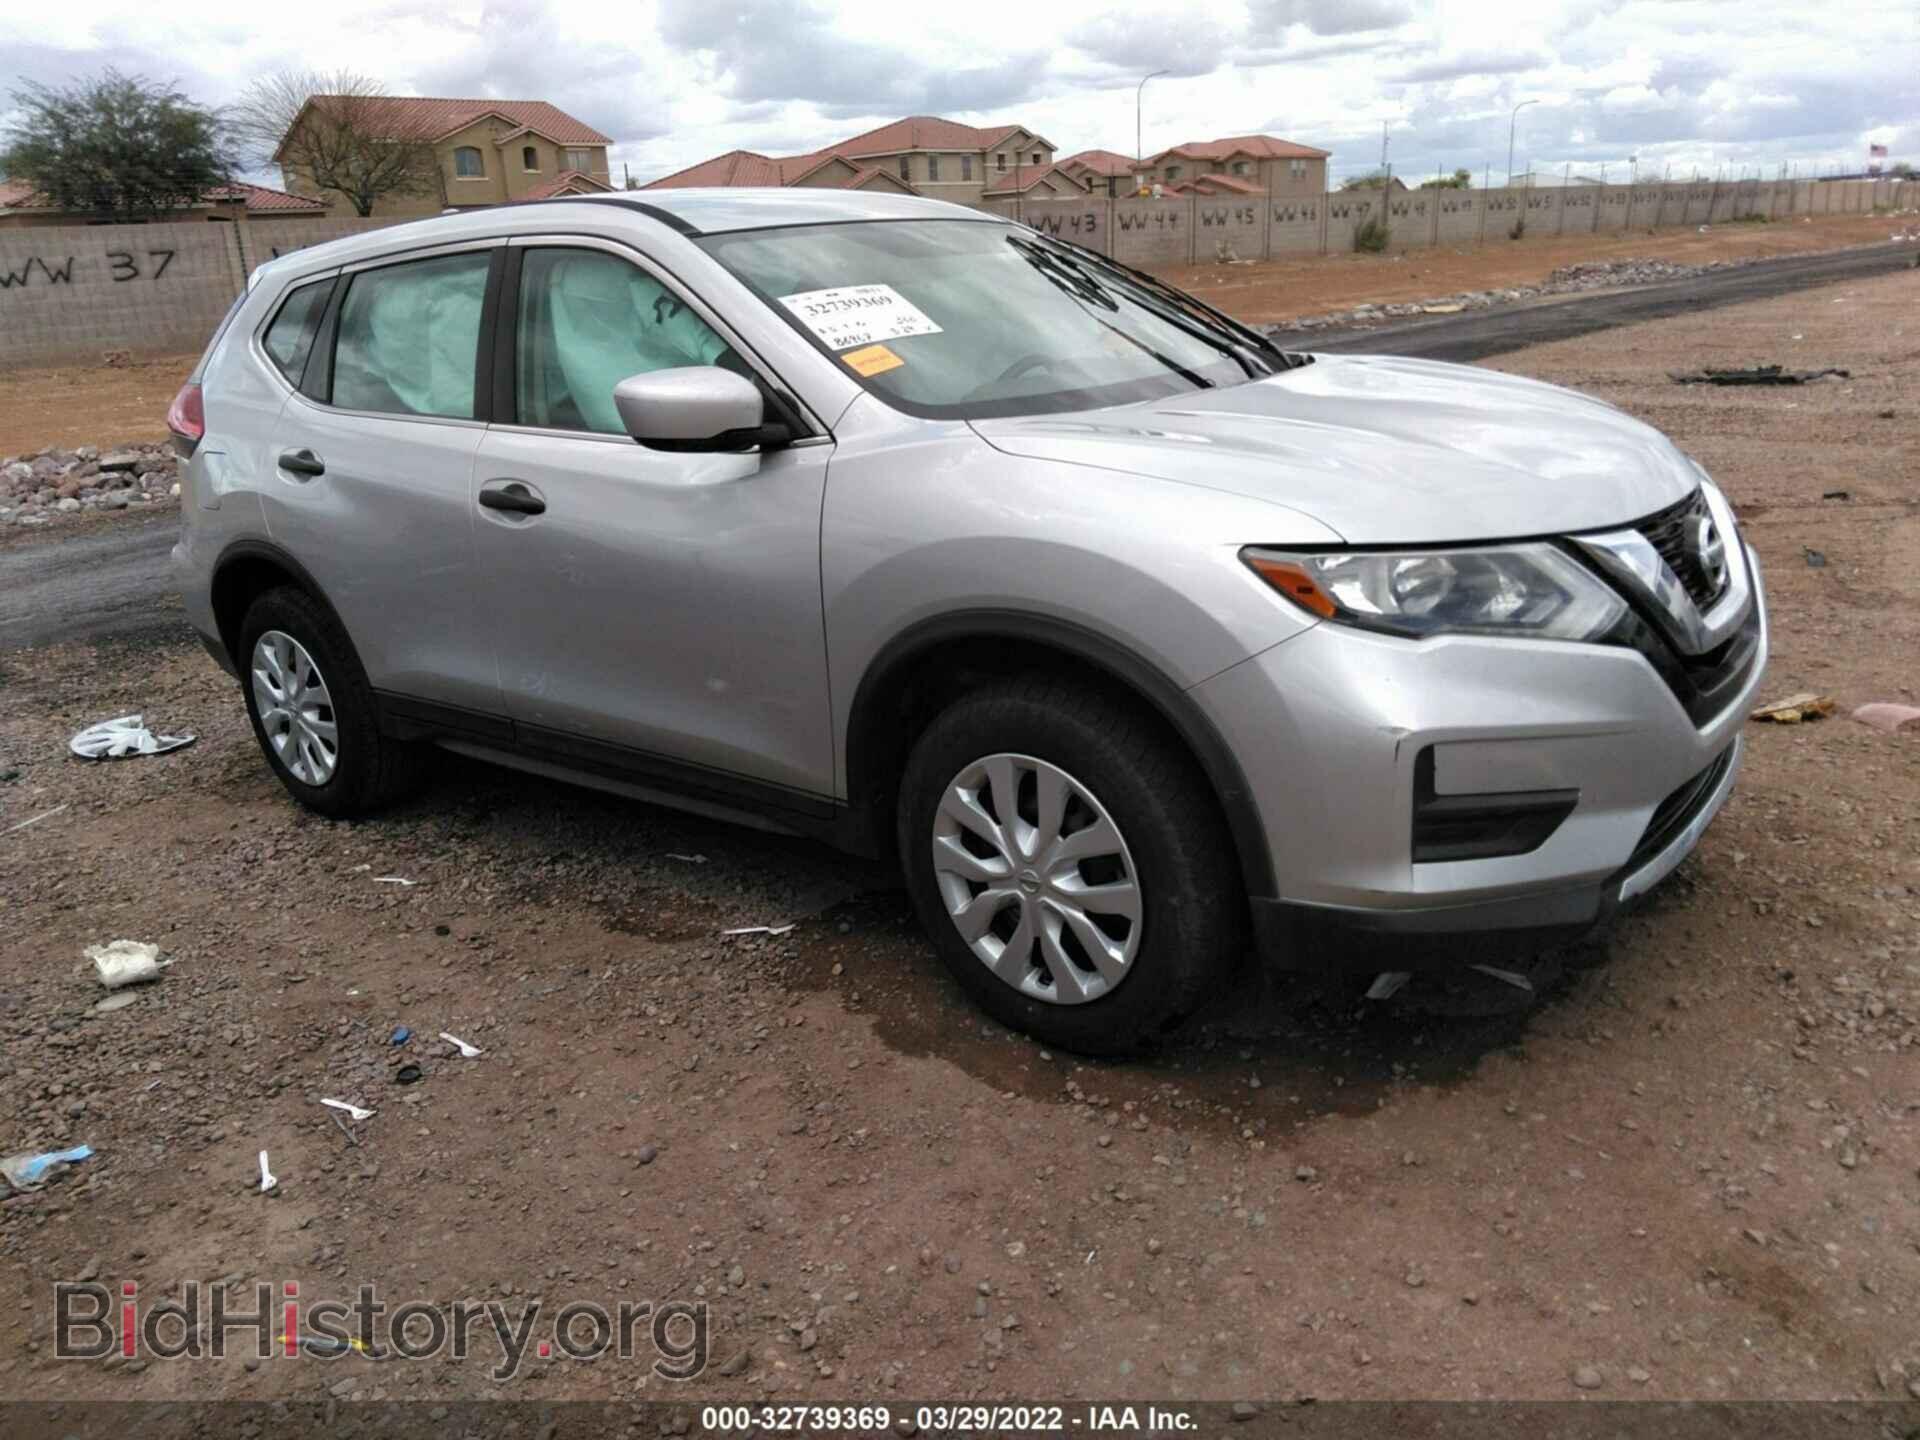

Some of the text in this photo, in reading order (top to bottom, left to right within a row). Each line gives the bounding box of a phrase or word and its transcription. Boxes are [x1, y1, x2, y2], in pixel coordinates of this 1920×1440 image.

[1029, 214, 1096, 234] WW 43
[1119, 211, 1177, 231] WW 44
[1202, 208, 1254, 226] WW 45
[106, 250, 174, 282] 37
